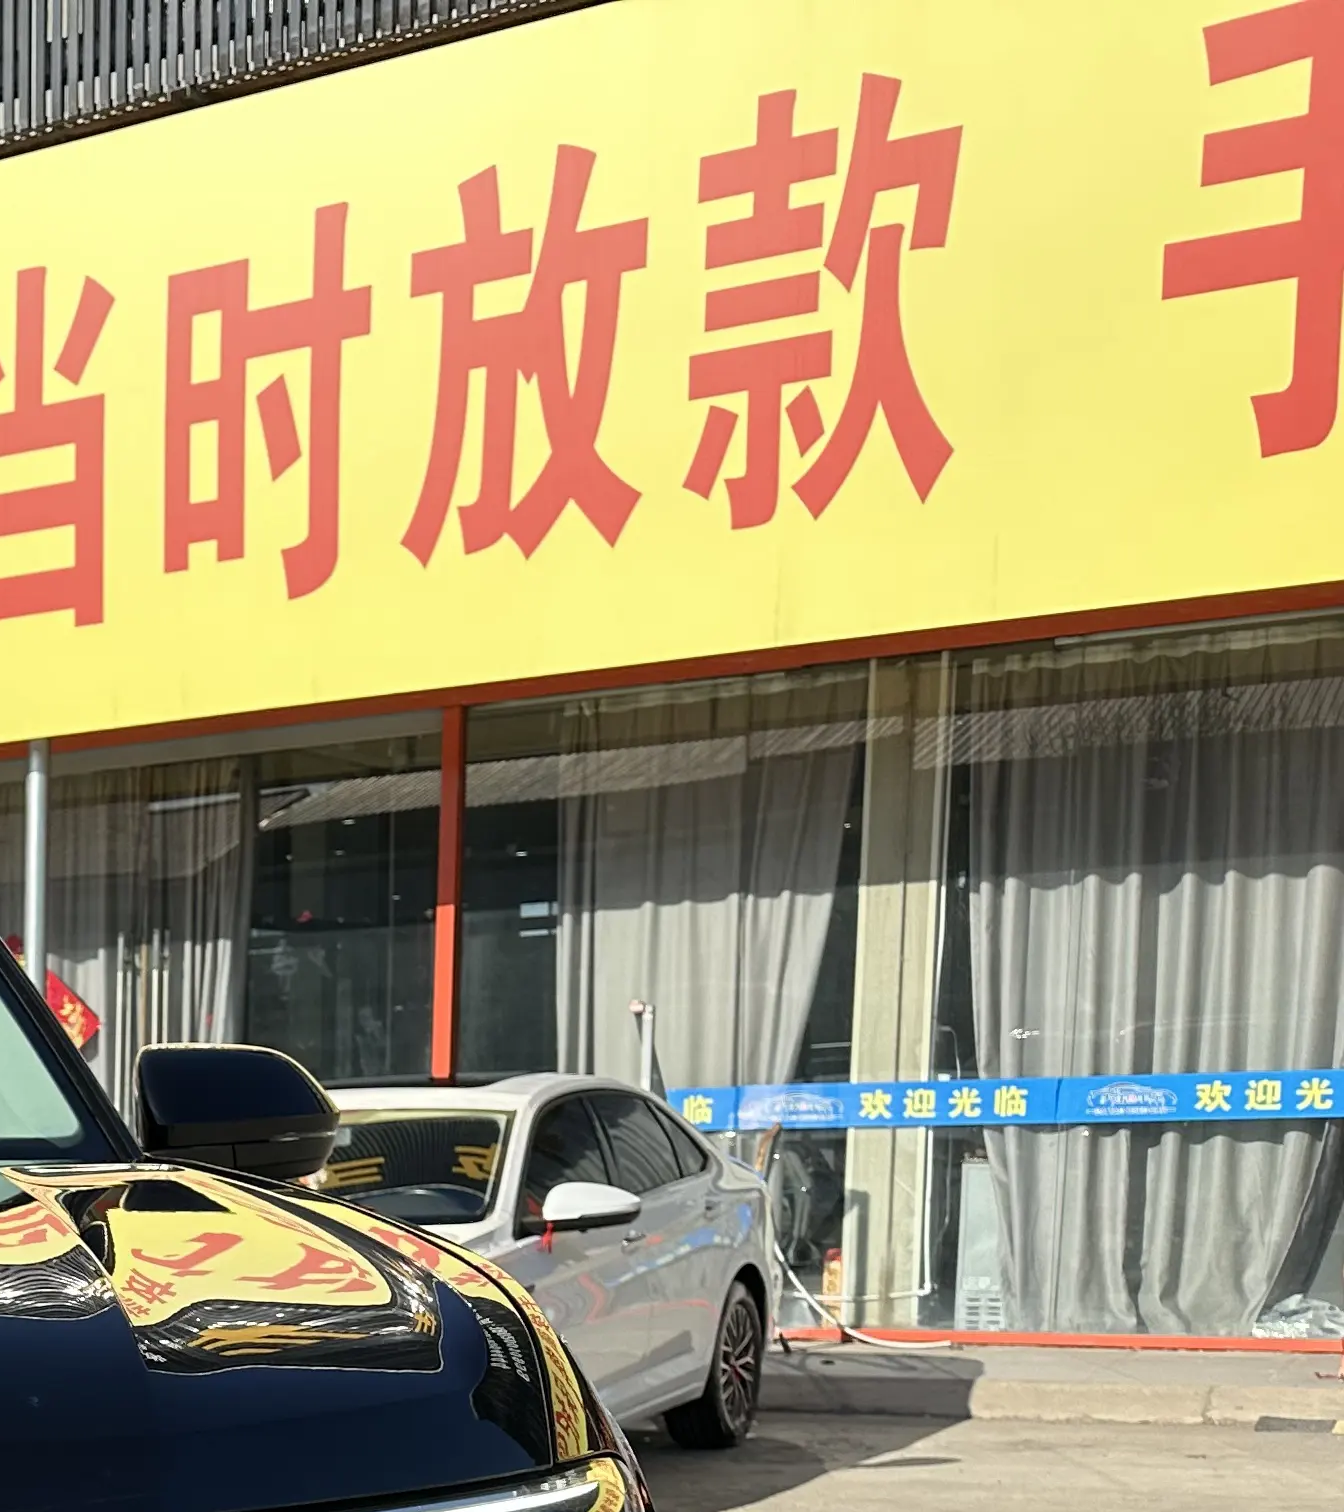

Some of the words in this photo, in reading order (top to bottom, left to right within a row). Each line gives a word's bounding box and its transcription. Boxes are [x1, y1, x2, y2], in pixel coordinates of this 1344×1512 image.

[858, 1085, 1029, 1119] 欢迎光临
[1193, 1077, 1335, 1112] 欢迎光
